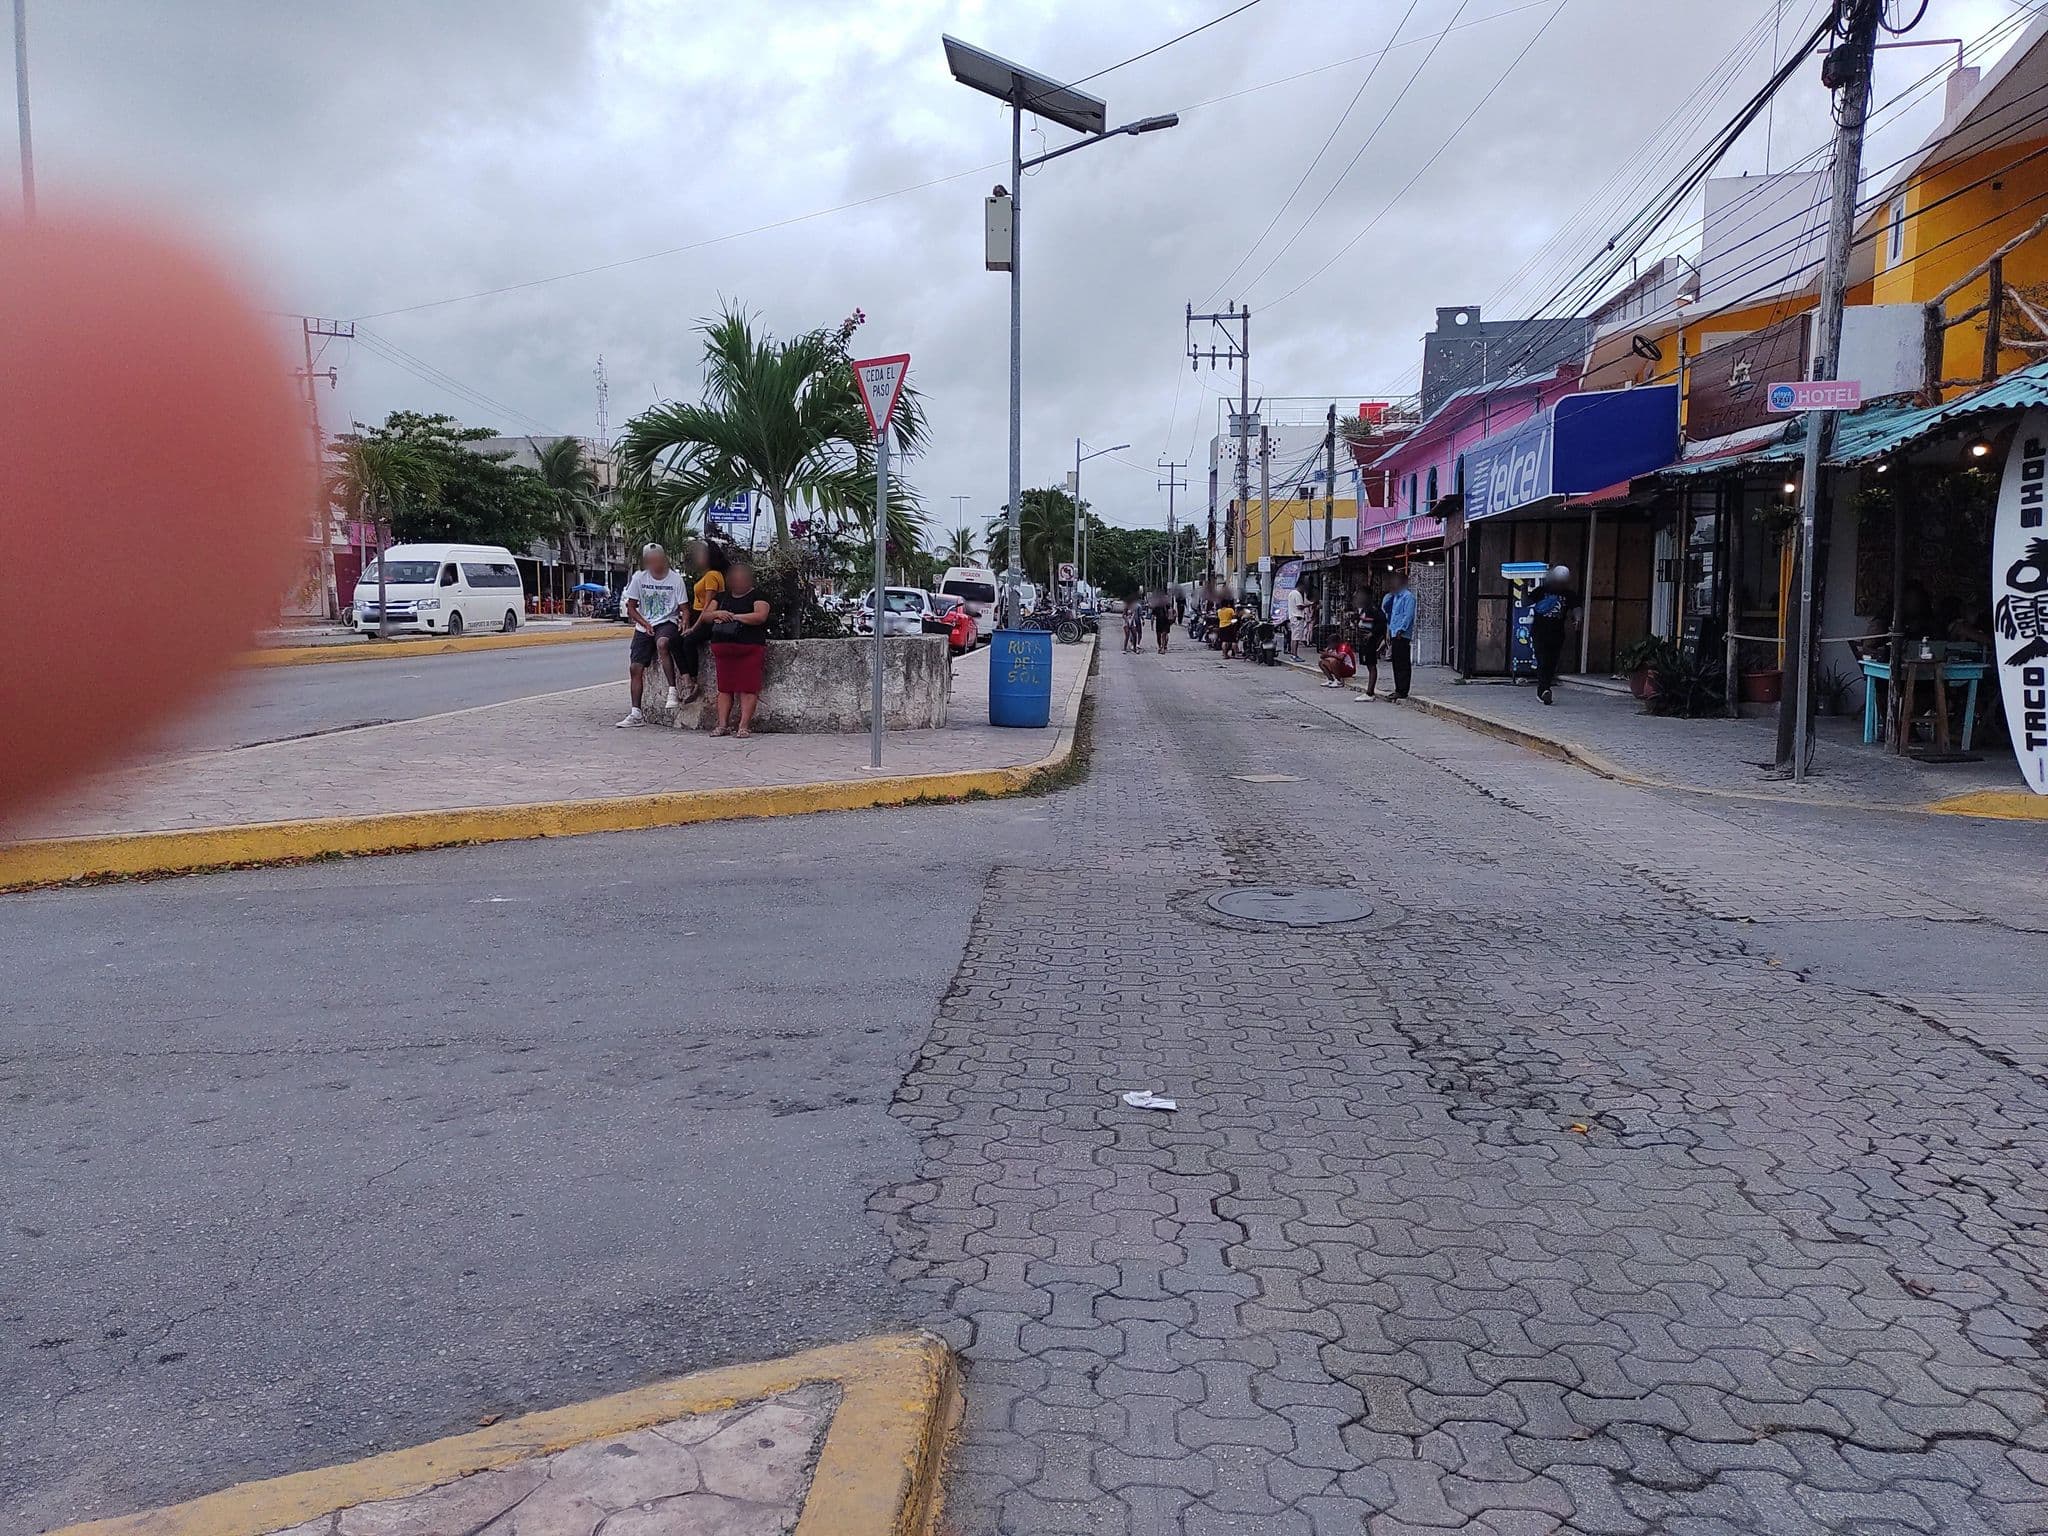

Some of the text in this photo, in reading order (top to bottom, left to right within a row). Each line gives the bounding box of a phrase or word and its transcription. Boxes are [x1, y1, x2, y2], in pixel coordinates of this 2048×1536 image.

[866, 366, 896, 382] CEDA EL
[872, 383, 890, 397] PASO
[1798, 388, 1858, 404] HOTEL
[1773, 396, 1792, 404] azul
[1486, 428, 1548, 514] telcel
[2020, 438, 2048, 752] TACO SHOP
[2009, 594, 2037, 639] CRAZY
[1008, 640, 1042, 654] RUTA
[1015, 656, 1039, 670] DEL
[1007, 671, 1038, 684] SOL
